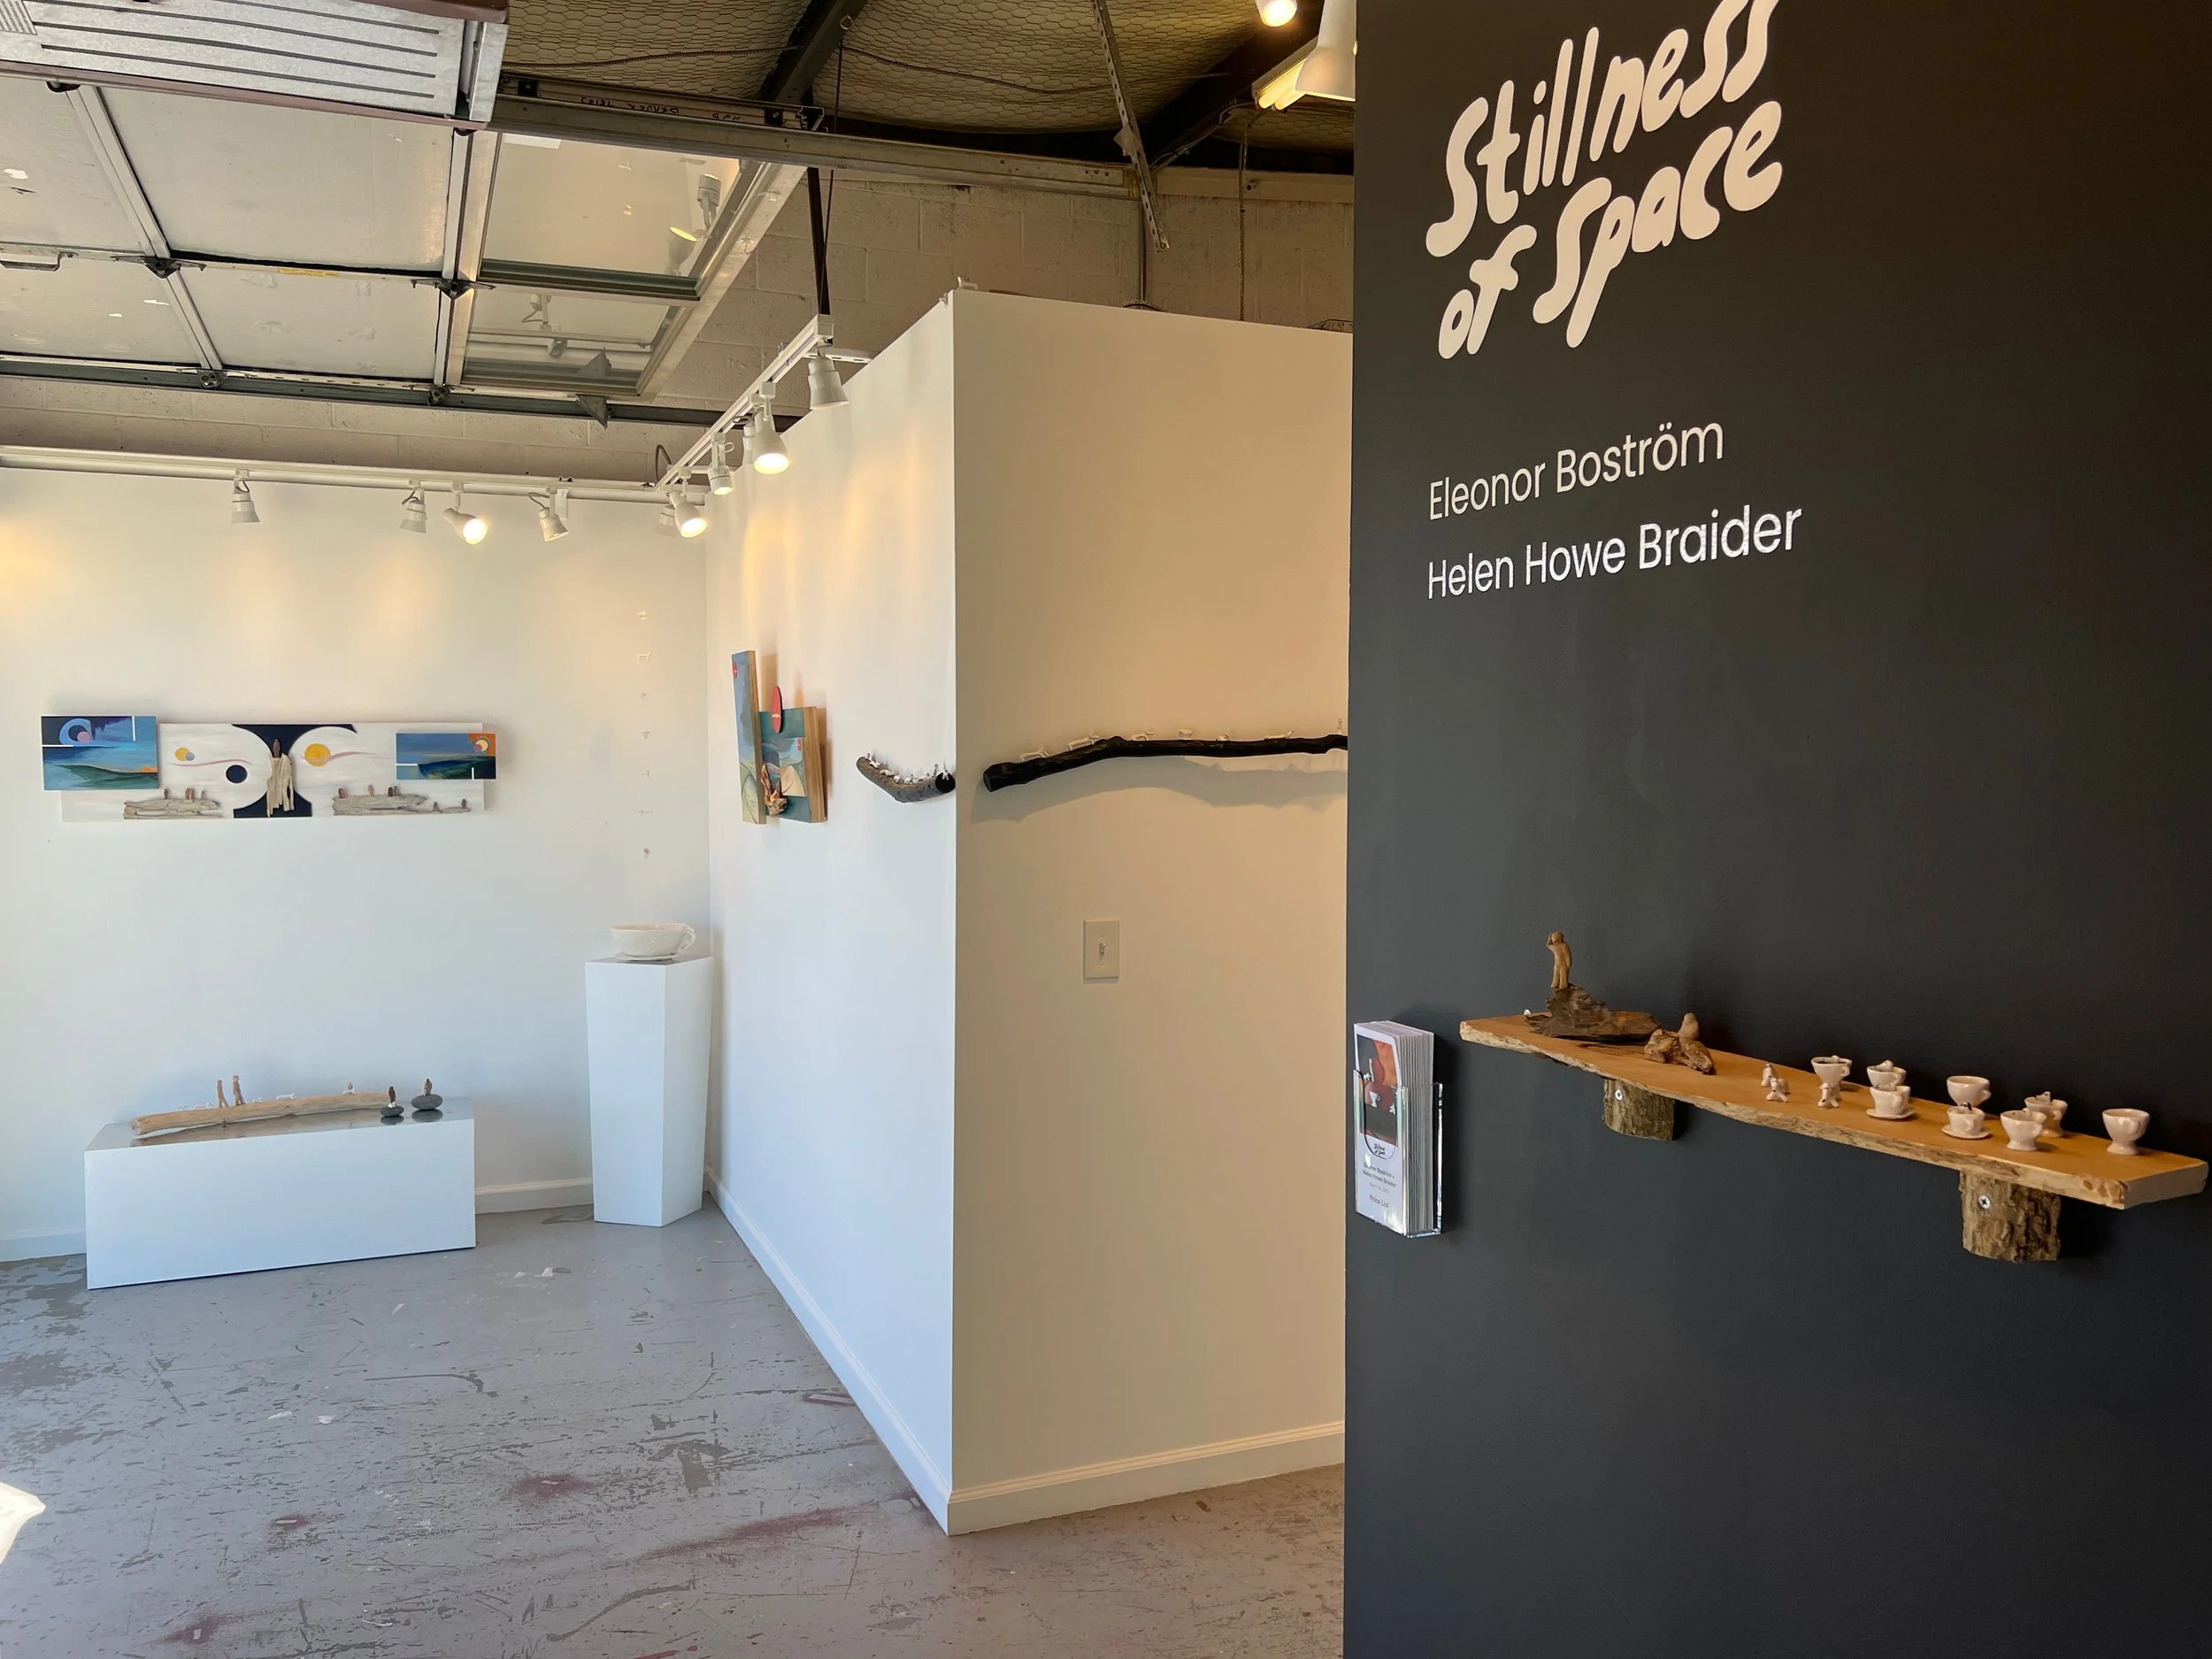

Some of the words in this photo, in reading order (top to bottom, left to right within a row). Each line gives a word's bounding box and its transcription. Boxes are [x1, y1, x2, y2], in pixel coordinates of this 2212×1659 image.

[1425, 0, 1779, 257] Stillness
[1438, 224, 1538, 359] of
[1532, 100, 1783, 349] Space
[1428, 552, 1515, 600] Helen
[1525, 536, 1627, 586] Howe
[1639, 504, 1802, 570] Braider
[1430, 462, 1547, 520] Eleonor
[1556, 421, 1724, 493] Boström
